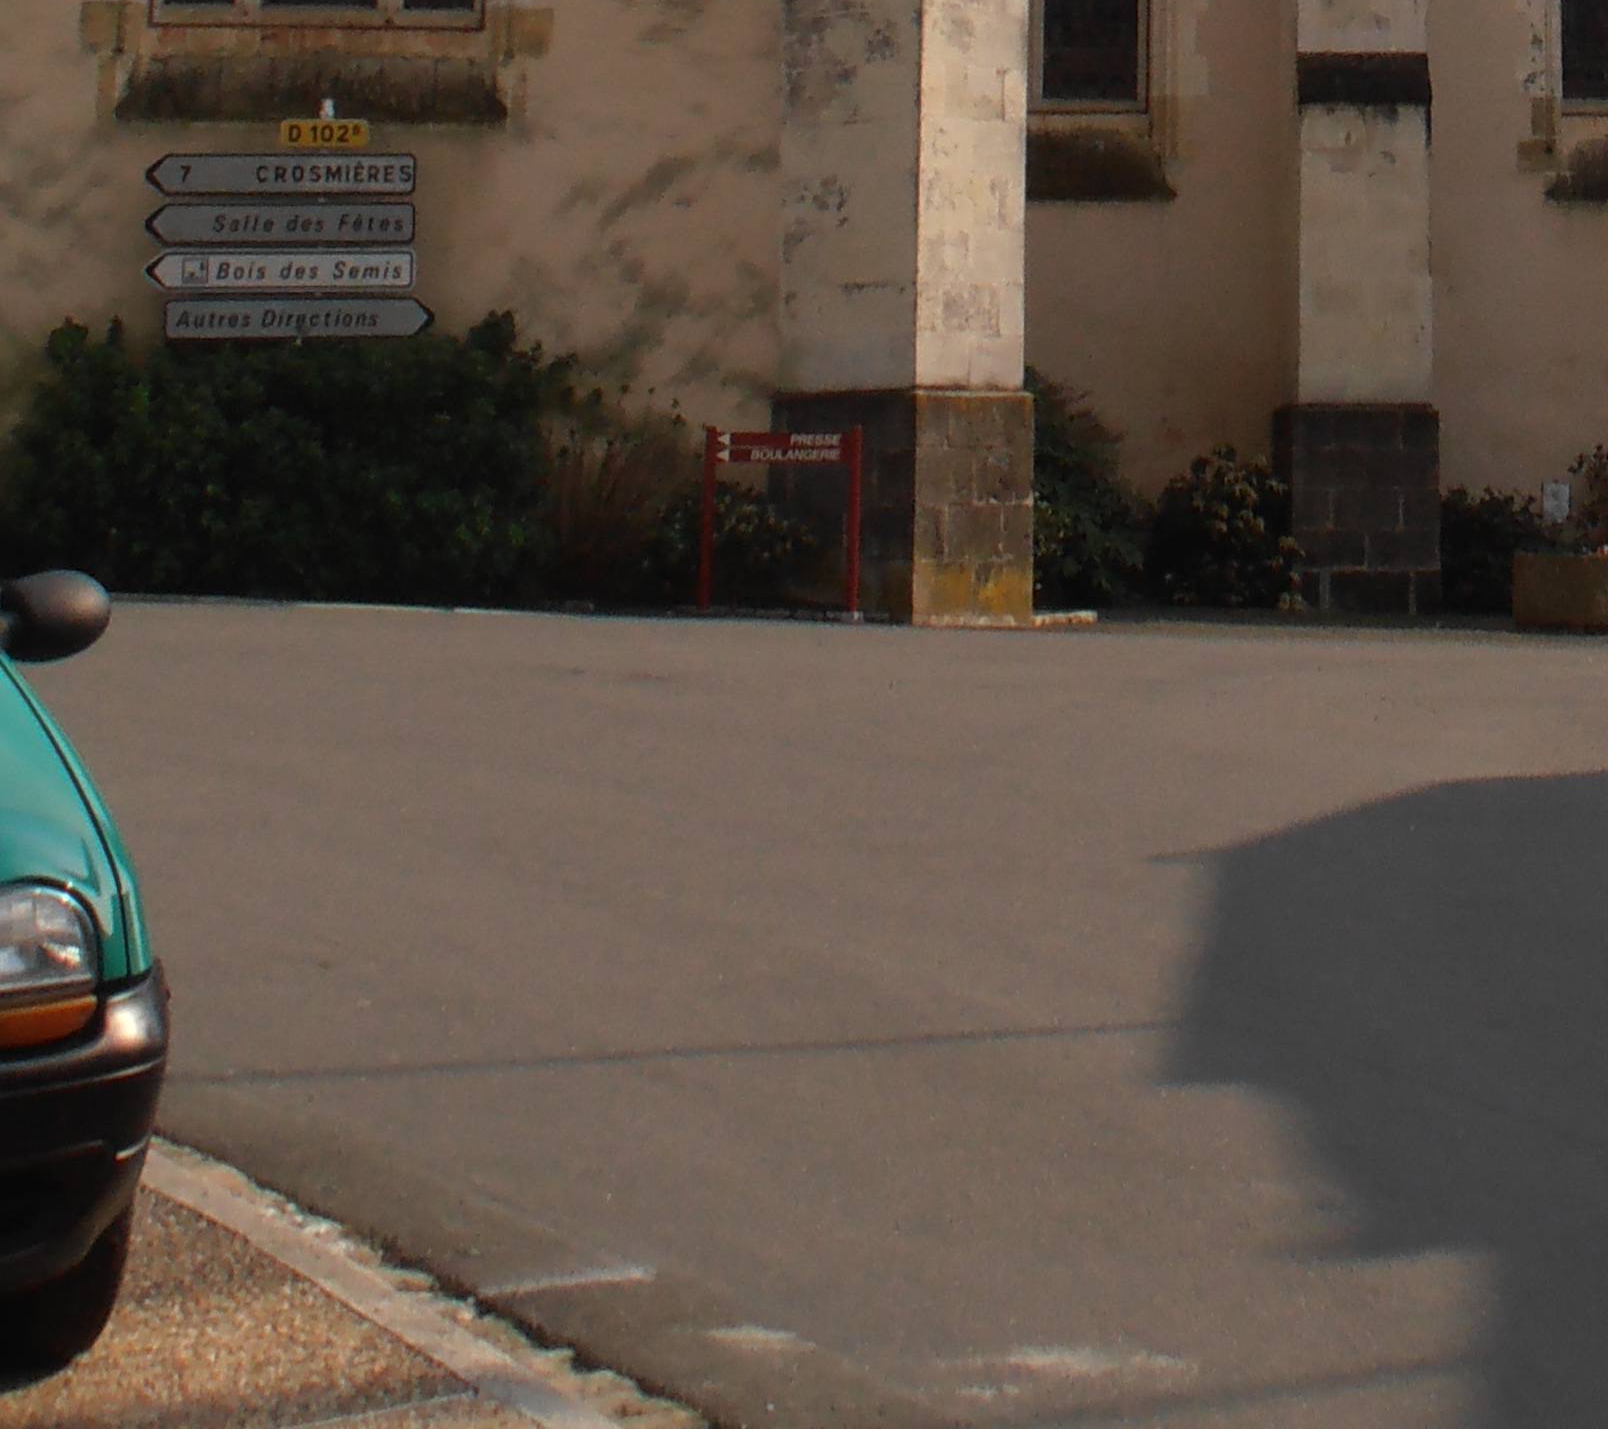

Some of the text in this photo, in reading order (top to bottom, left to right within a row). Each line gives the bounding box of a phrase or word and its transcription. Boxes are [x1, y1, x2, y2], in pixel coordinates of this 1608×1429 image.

[288, 124, 301, 142] D
[180, 165, 192, 183] 7
[212, 213, 404, 232] Salle des Fêtes
[216, 260, 402, 280] Bois des Semis
[175, 308, 379, 328] Autres Directions
[790, 433, 842, 446] PRESSE
[750, 448, 841, 461] BOULANGERIE
